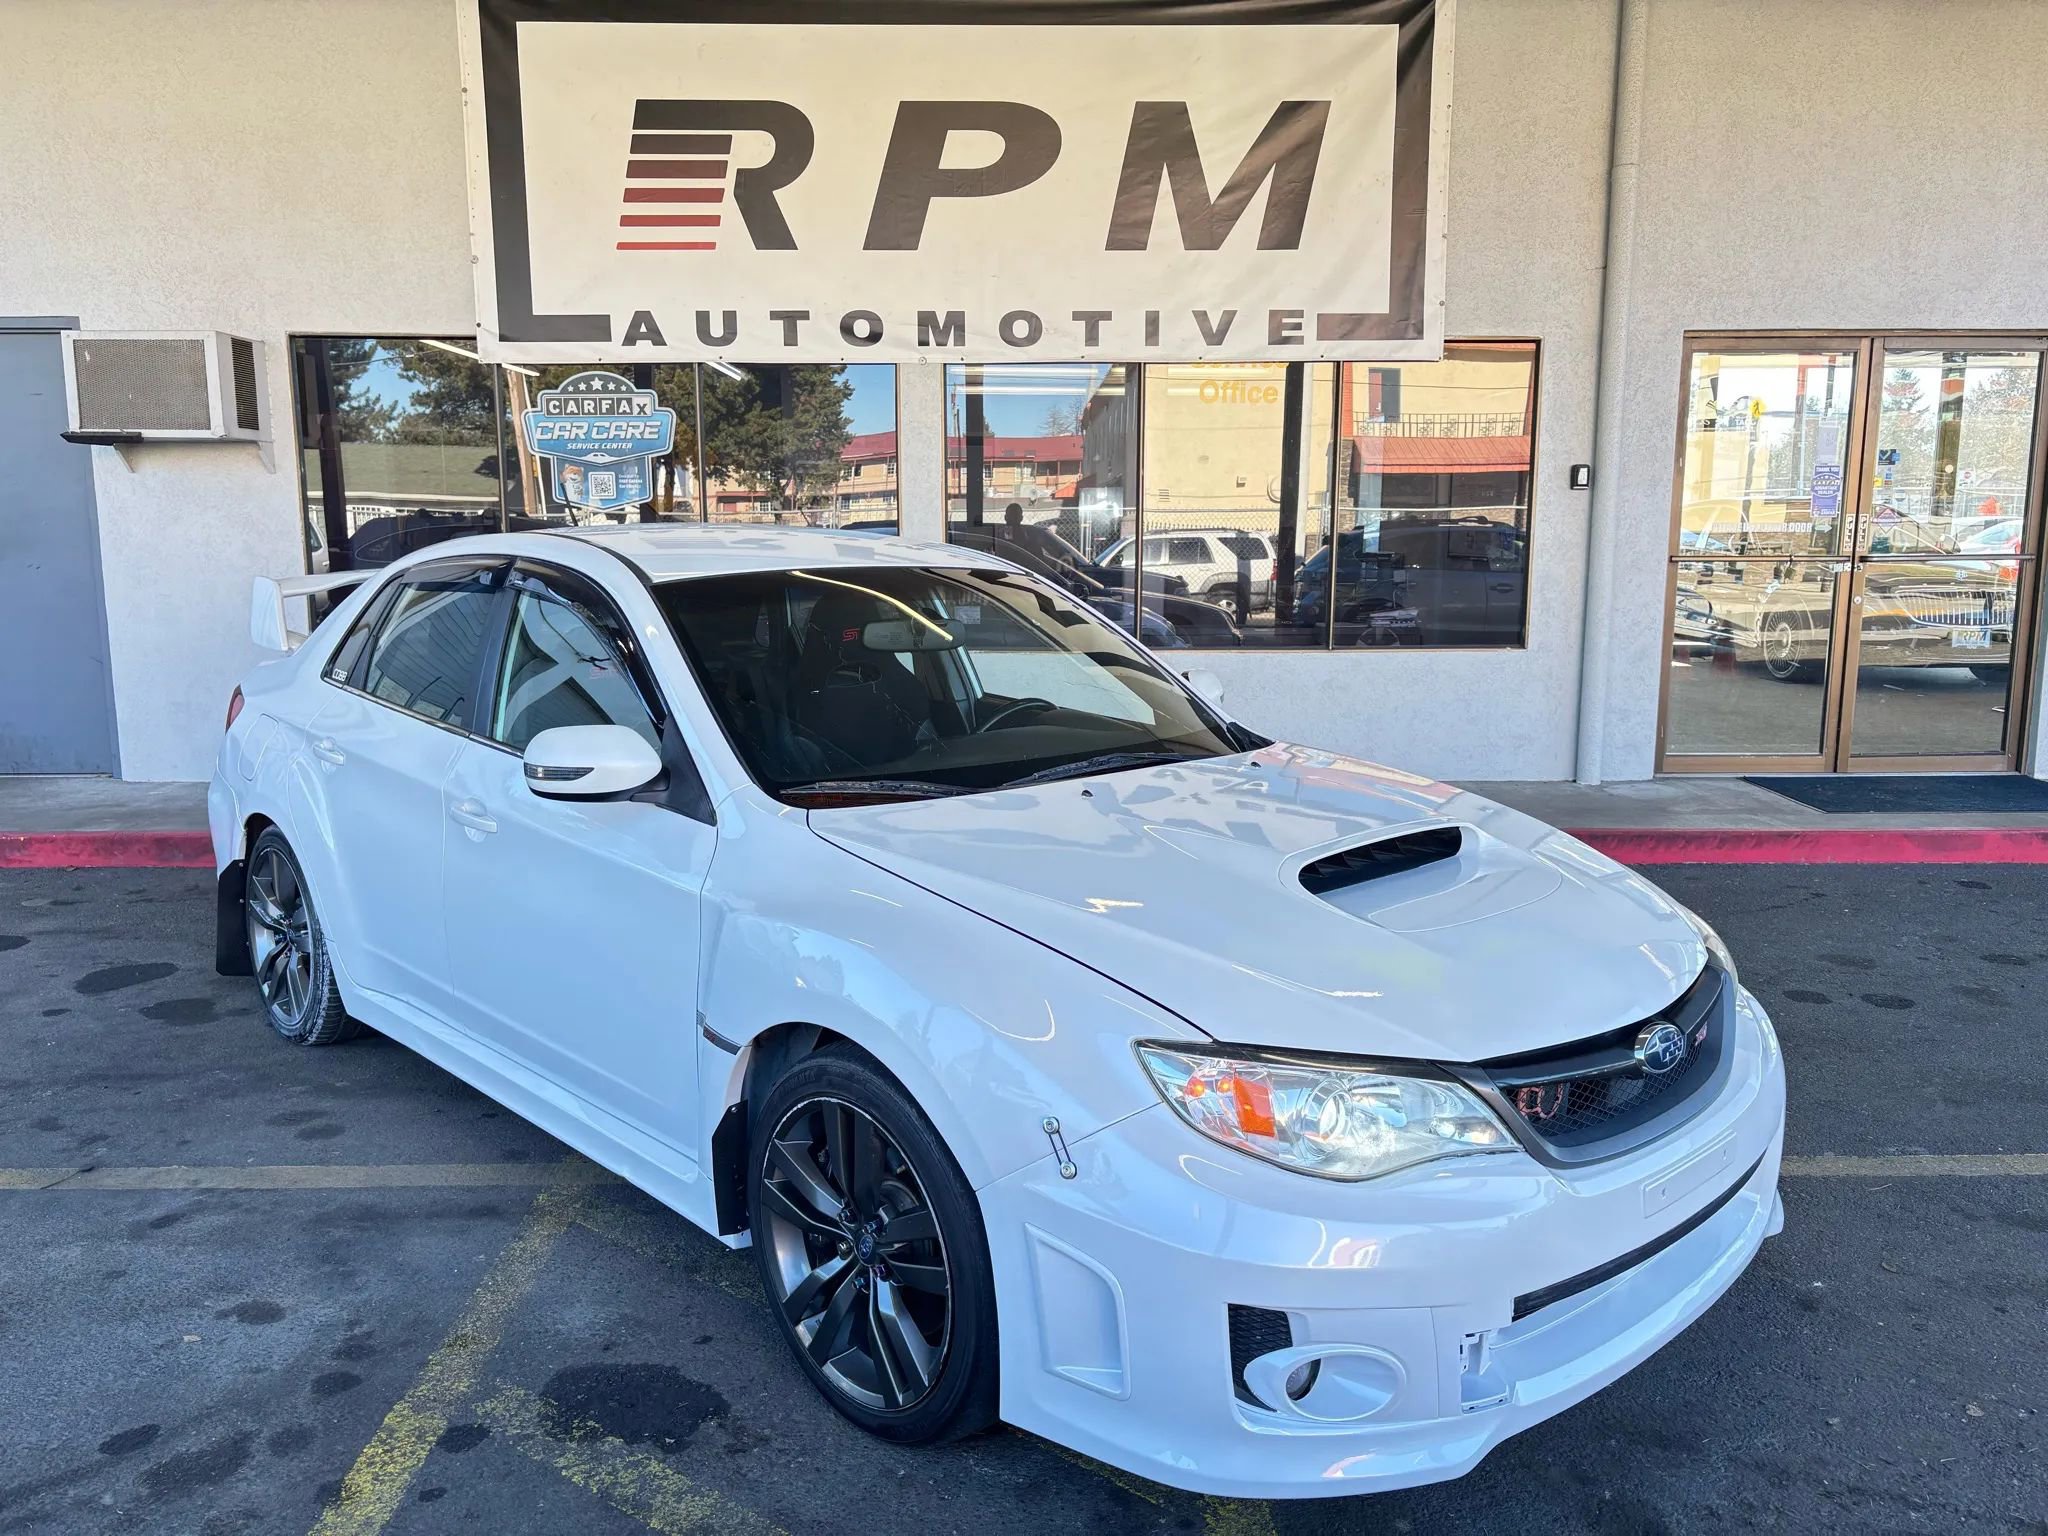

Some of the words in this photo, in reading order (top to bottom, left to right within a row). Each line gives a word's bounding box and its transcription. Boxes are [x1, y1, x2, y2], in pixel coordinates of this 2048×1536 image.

[616, 99, 1331, 251] RPM
[622, 308, 1305, 348] AUTOMOTIVE
[1200, 380, 1278, 404] Office
[548, 399, 648, 416] CARFAX
[535, 421, 589, 440] CAR
[591, 421, 662, 440] CARE
[567, 442, 600, 450] SERVICE
[601, 442, 633, 450] CENTER
[1859, 516, 1867, 542] PULL
